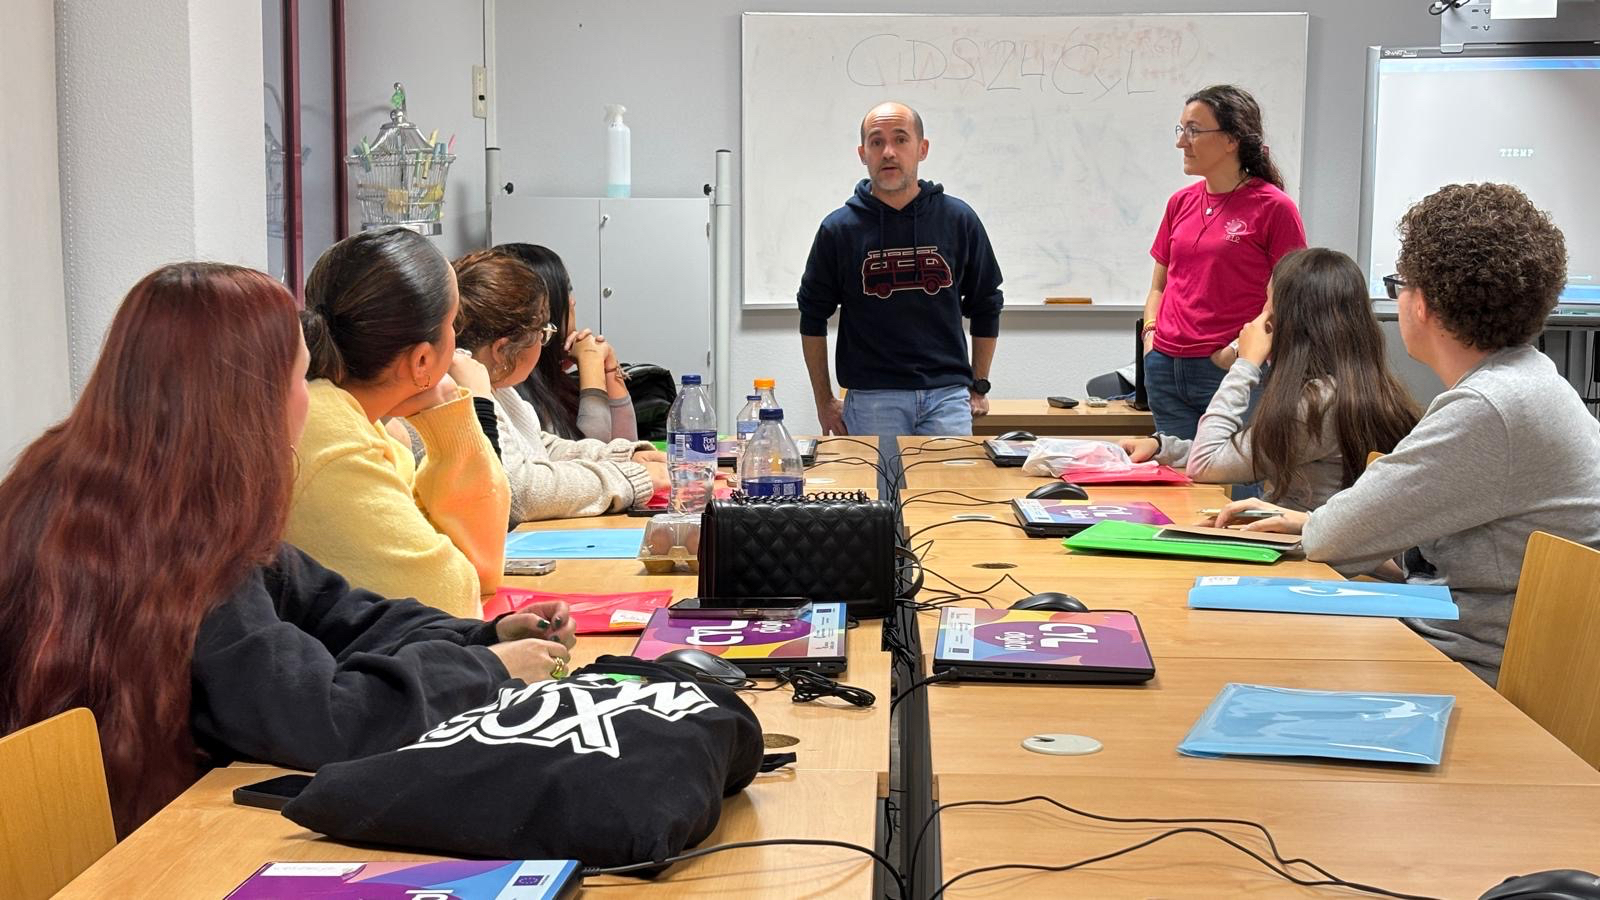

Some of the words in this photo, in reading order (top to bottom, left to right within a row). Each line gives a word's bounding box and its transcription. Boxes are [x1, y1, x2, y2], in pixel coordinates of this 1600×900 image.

[686, 620, 749, 646] CYL
[995, 631, 1036, 652] digital
[1038, 623, 1099, 648] CYL
